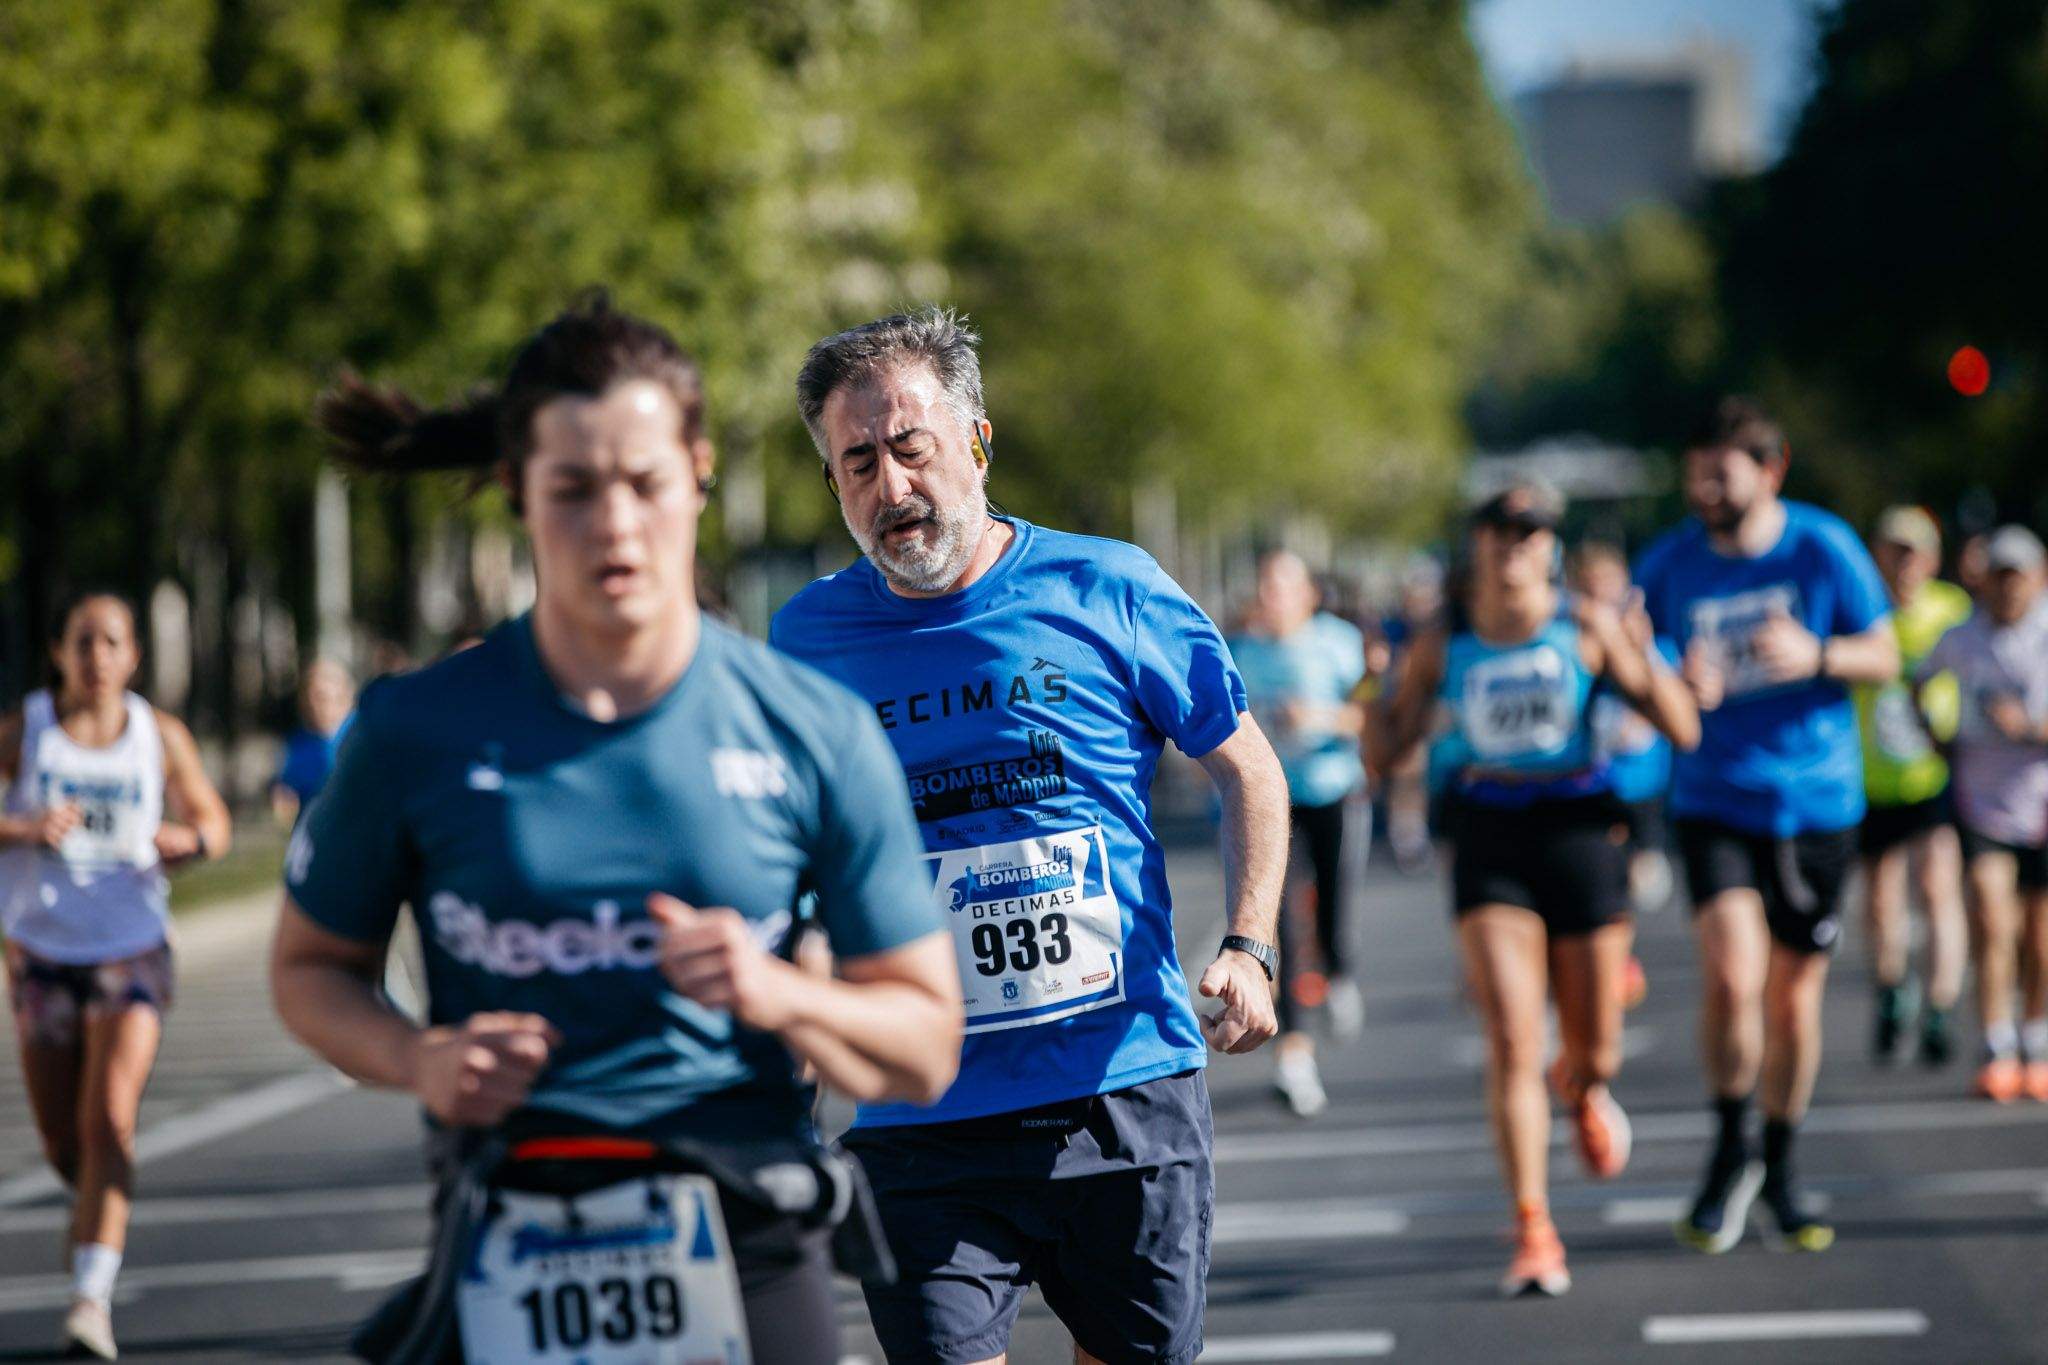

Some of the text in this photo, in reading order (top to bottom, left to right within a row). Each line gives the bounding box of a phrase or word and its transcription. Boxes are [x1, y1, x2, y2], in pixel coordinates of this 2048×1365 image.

[875, 674, 1068, 730] ECIMAS
[909, 756, 1057, 799] BOMBEROS
[970, 773, 1062, 809] de MADRID
[979, 861, 1069, 887] BOMBEROS
[1034, 873, 1073, 894] MADRID
[972, 890, 1075, 919] DECIMAS
[428, 890, 793, 980] Reeb
[971, 912, 1073, 977] 933
[520, 1275, 683, 1353] 1039
